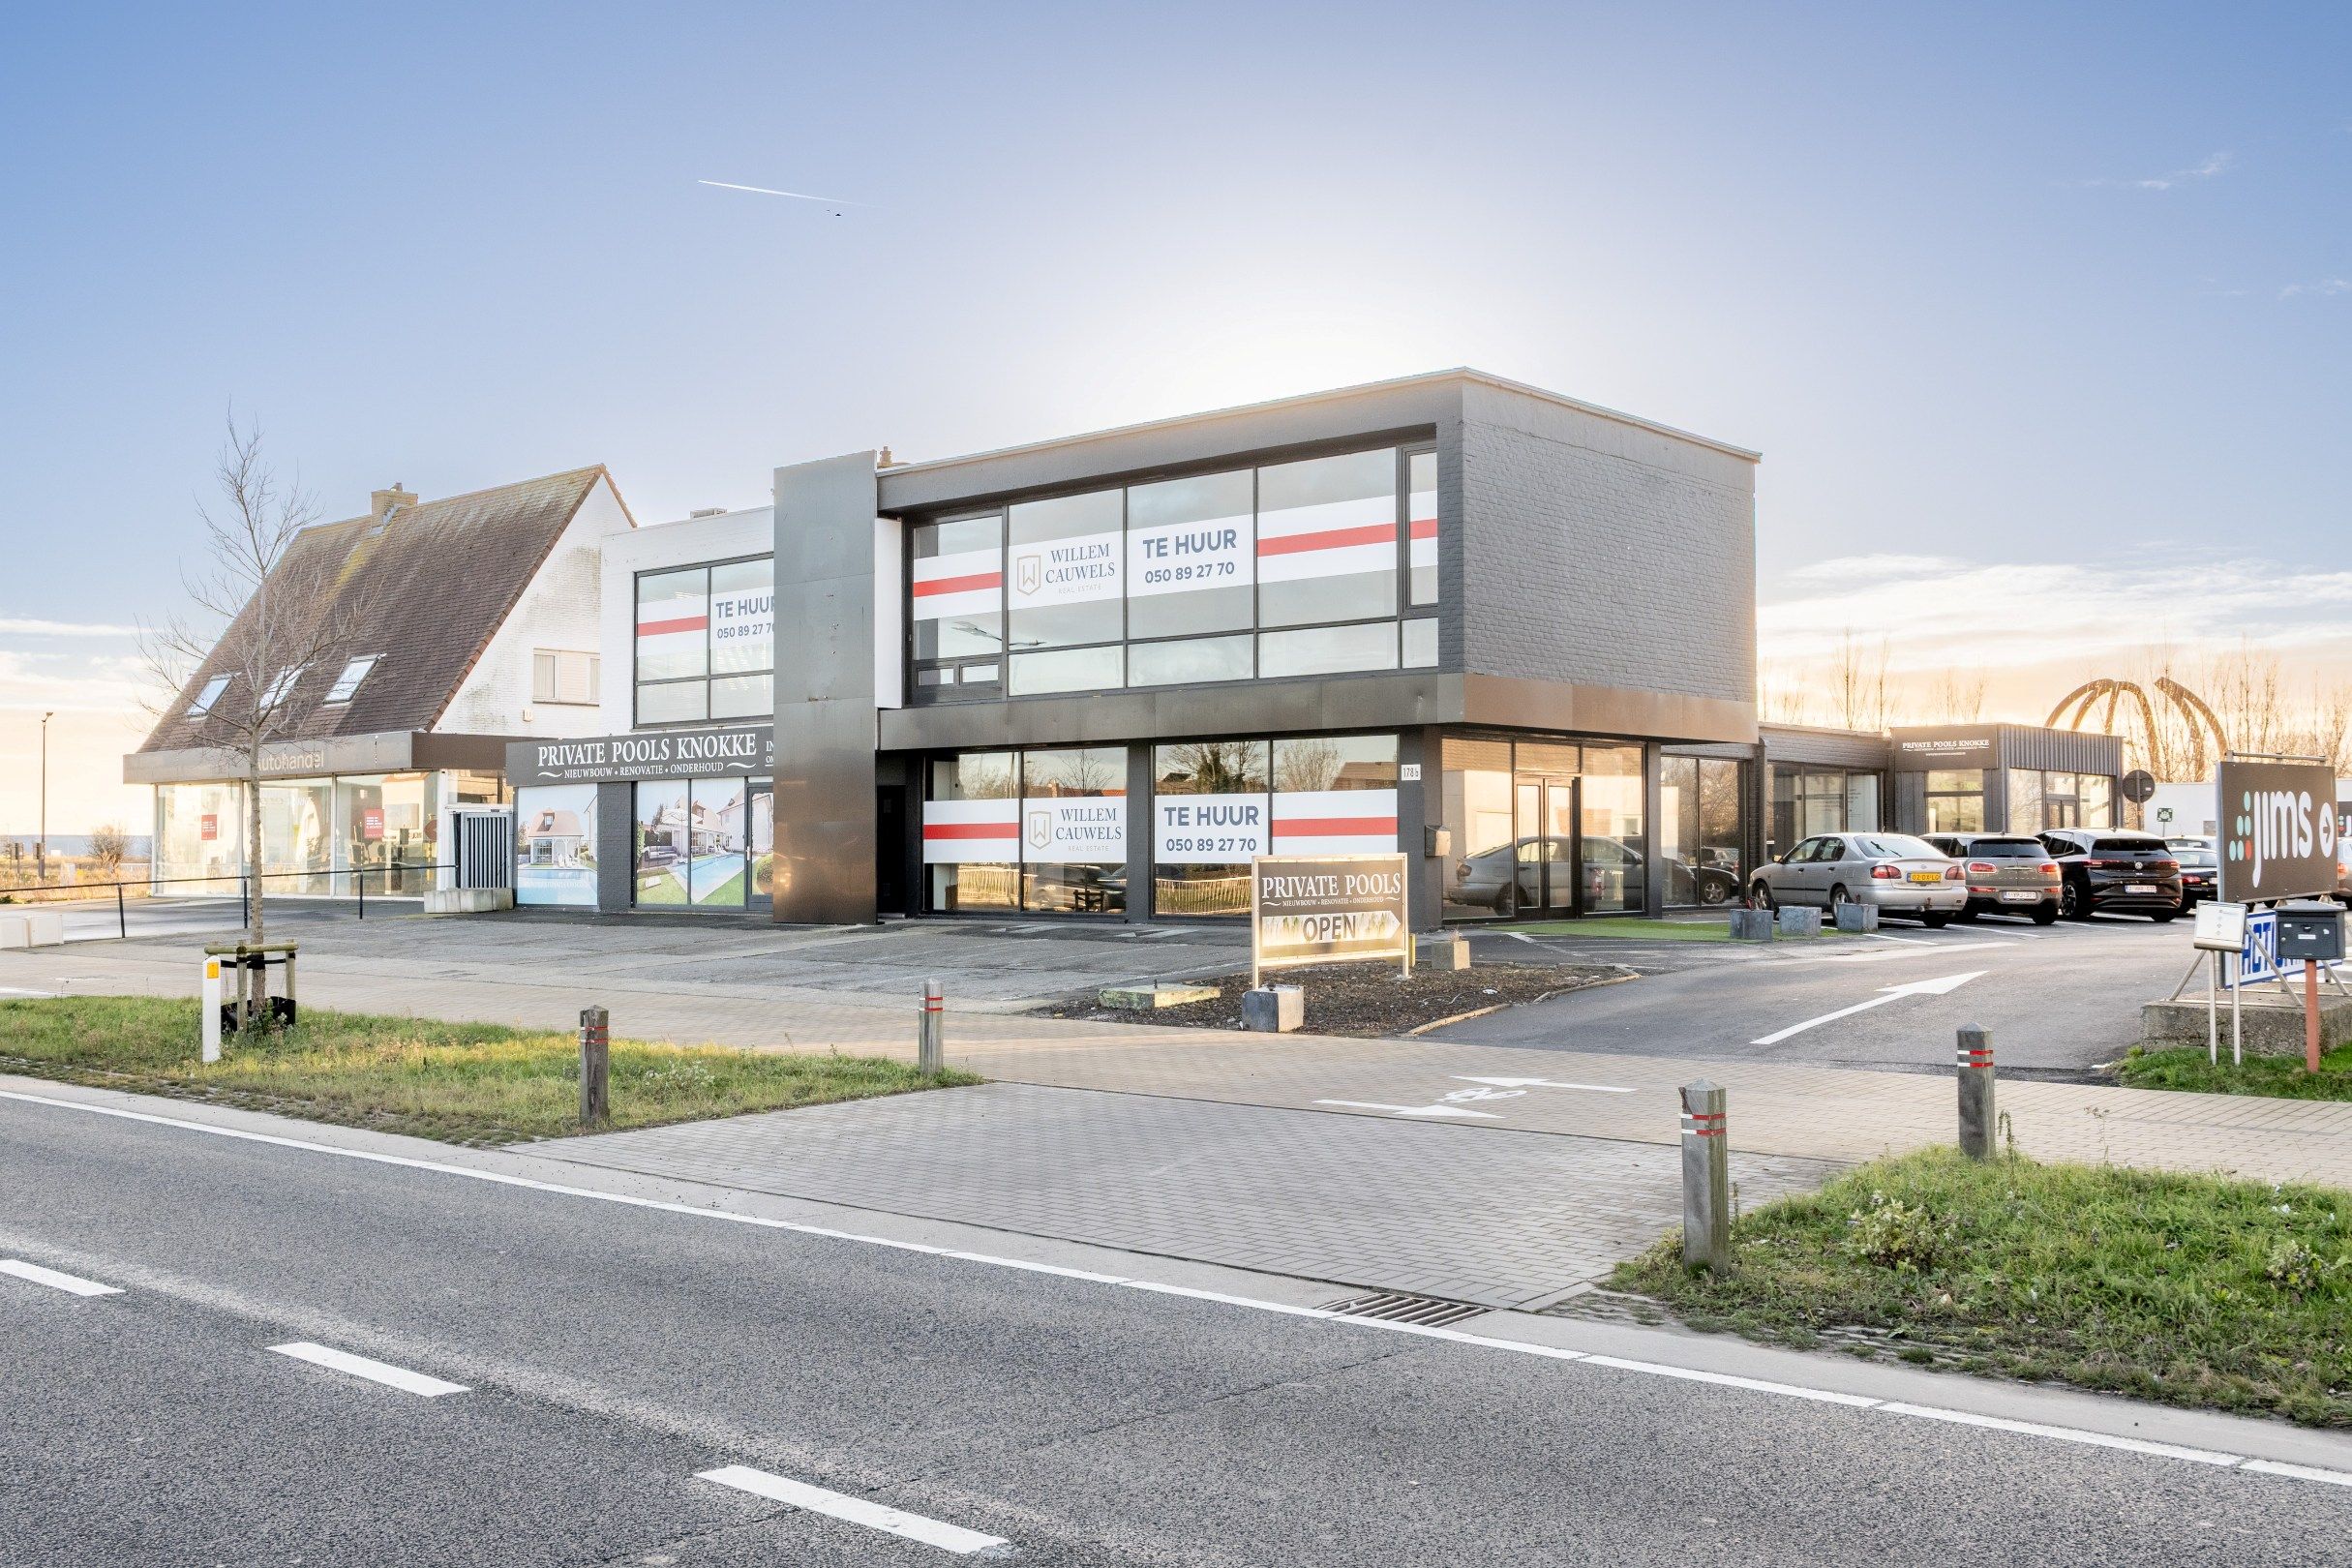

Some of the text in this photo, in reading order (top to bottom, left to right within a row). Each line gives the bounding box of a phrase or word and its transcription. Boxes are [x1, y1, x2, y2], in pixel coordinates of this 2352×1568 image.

[1143, 528, 1237, 559] TE HUUR
[1050, 543, 1110, 563] WILLEM
[1045, 561, 1115, 584] CAUWELS
[1145, 561, 1235, 584] 050 89 27 70
[1058, 584, 1102, 595] REAL ESTATE
[715, 601, 734, 618] TE
[717, 627, 736, 639] 050
[738, 624, 750, 637] 89
[752, 623, 764, 635] 27
[537, 733, 757, 767] PRIVATE POOLS KNOKKE
[1958, 739, 1990, 747] KNOKKE
[257, 748, 324, 771] utohandel
[564, 762, 724, 779] NIEUWBOUW RENOVATIE ONDERHOUD
[1060, 807, 1117, 822] WILLEM
[1164, 805, 1259, 827] TE HUUR
[1055, 826, 1122, 840] CAUWELS
[1166, 838, 1257, 852] 050 89 27 70
[1261, 872, 1402, 899] PRIVATE POOLS
[1282, 898, 1316, 907] NIEUWBOUW
[1320, 897, 1349, 906] RENOVATIE
[1303, 915, 1356, 942] OPEN
